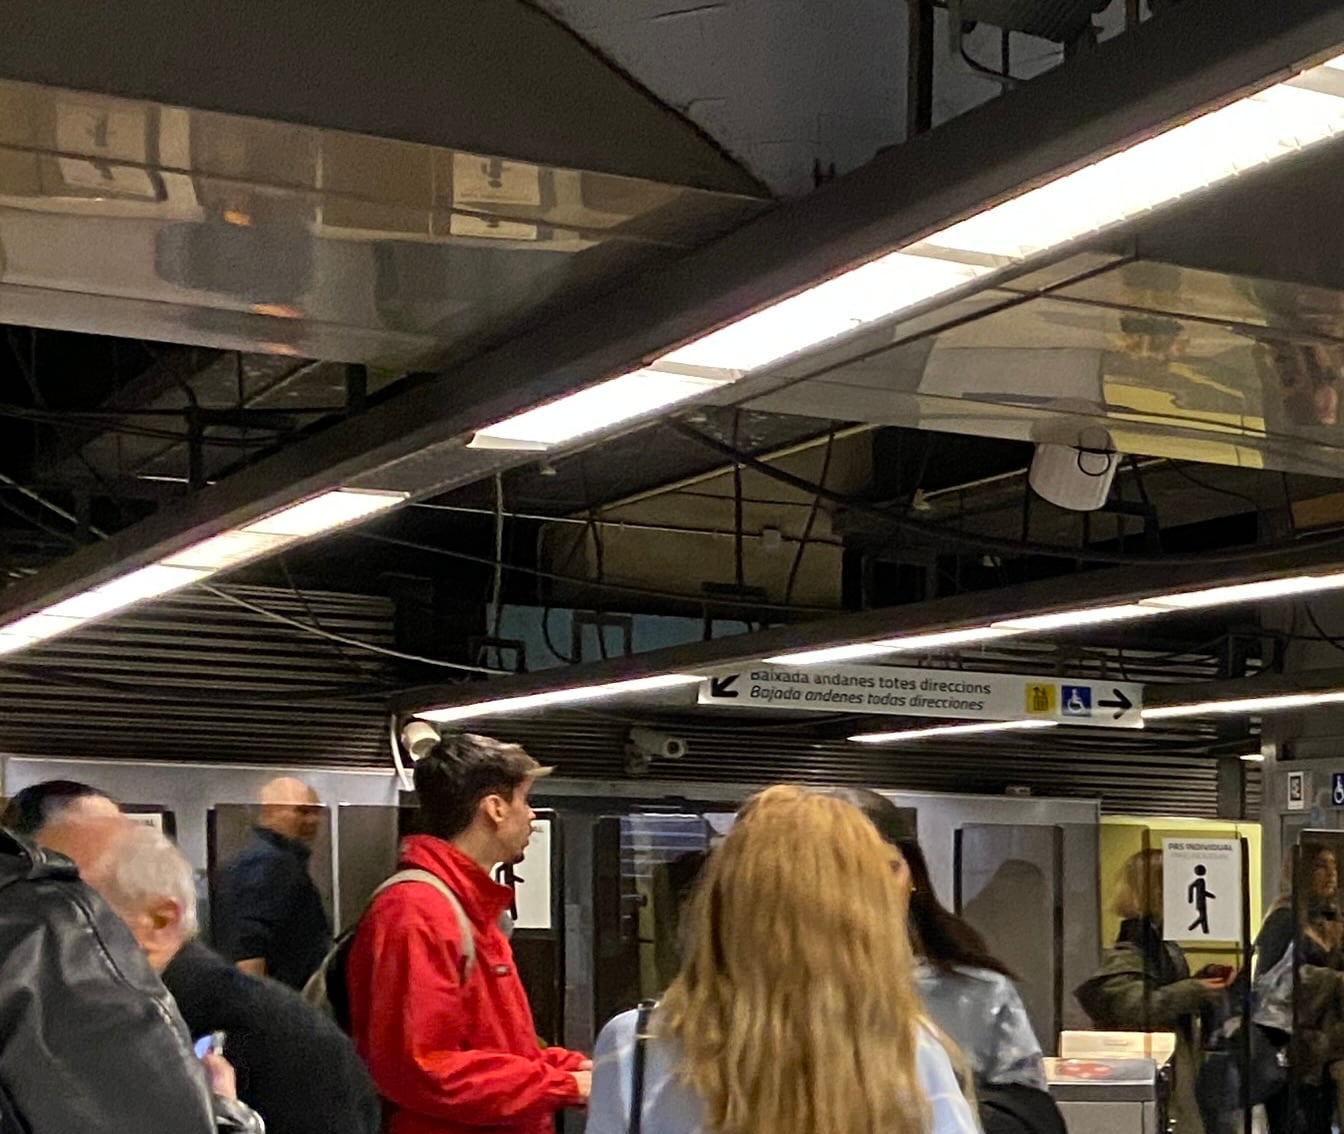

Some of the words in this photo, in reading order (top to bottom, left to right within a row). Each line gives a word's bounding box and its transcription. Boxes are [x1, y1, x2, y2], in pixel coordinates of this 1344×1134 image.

[751, 670, 809, 684] Baixada
[814, 673, 875, 688] andanes
[879, 676, 916, 691] totes
[920, 677, 991, 695] direccions
[751, 685, 801, 703] Bajada
[805, 689, 863, 705] andenes
[867, 690, 906, 707] todas
[909, 692, 984, 711] direcciones
